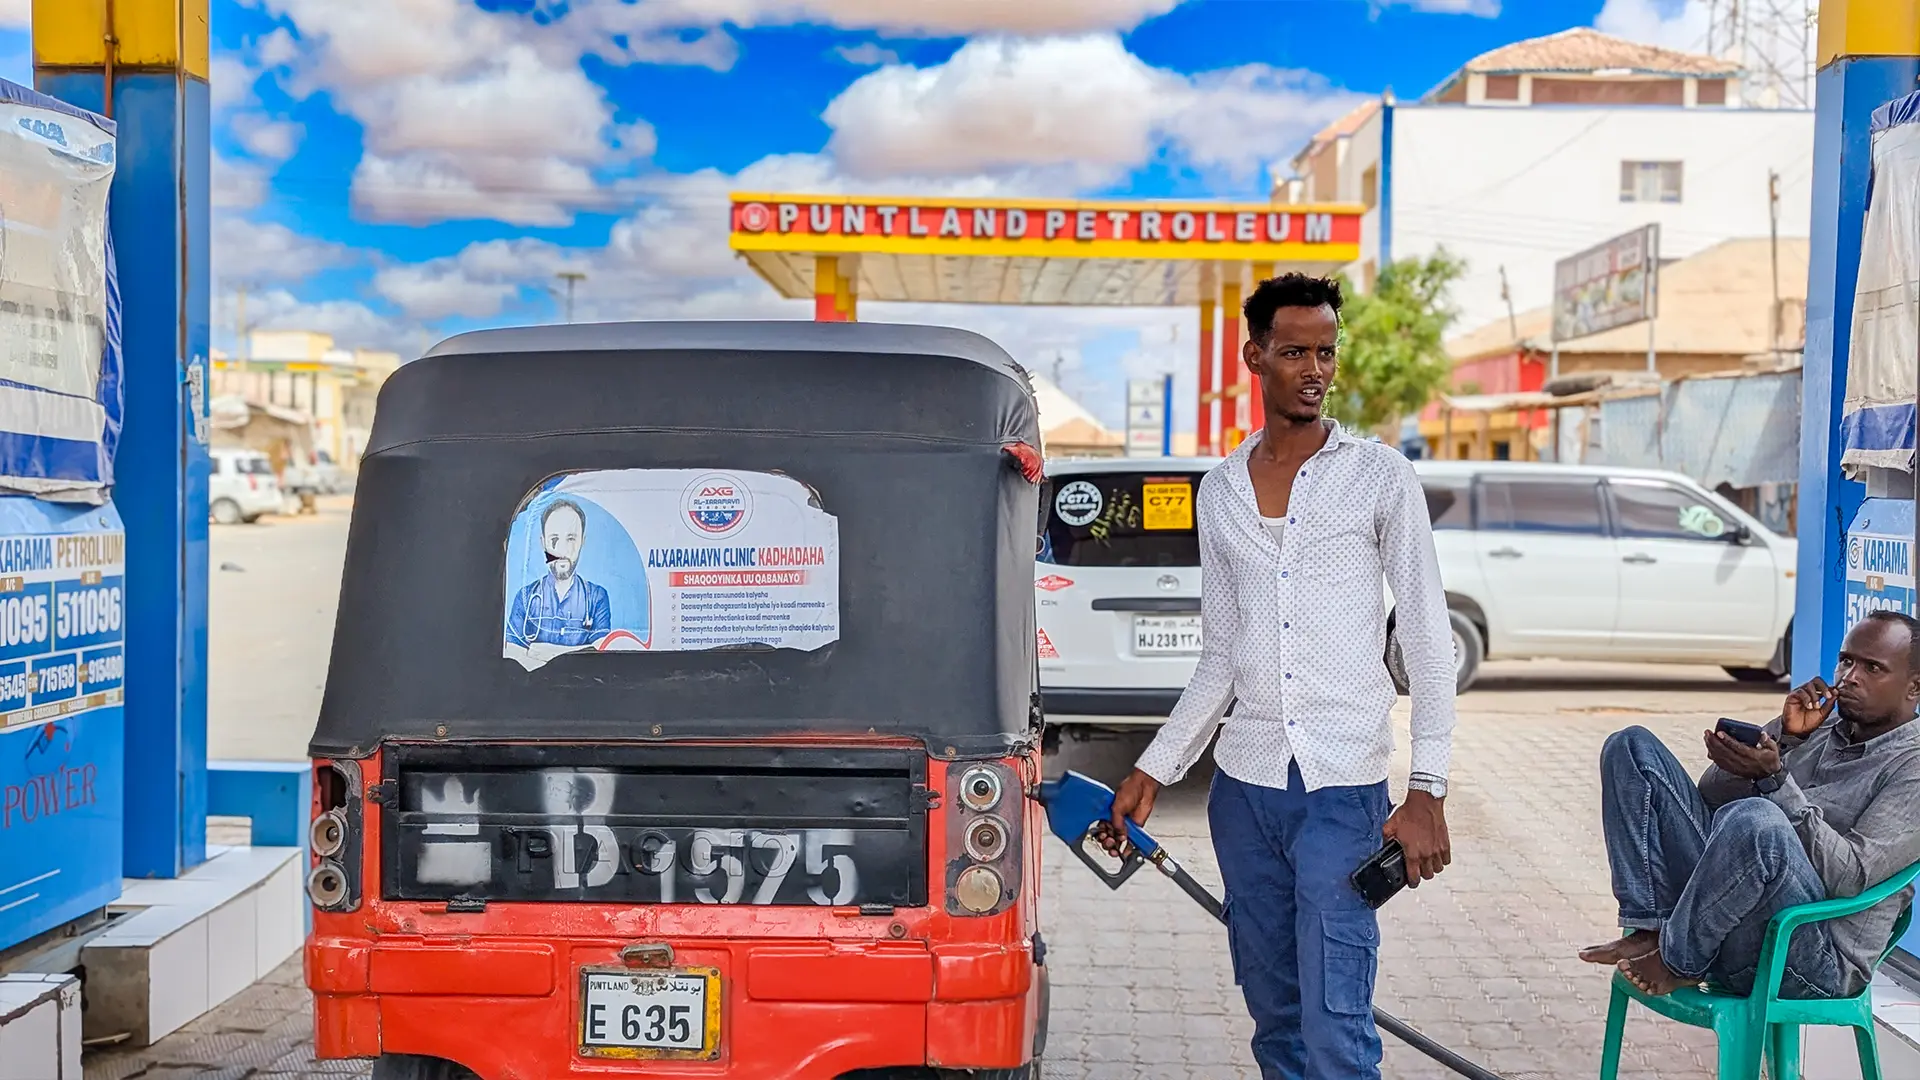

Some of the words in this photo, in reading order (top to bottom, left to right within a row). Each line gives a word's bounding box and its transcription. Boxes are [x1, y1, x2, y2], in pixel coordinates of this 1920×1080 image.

[778, 202, 1028, 238] PUNTLAND
[1044, 209, 1333, 243] PETROLEUM
[699, 487, 733, 496] AXG
[1066, 493, 1090, 503] C77
[1149, 496, 1185, 506] C77
[57, 535, 123, 568] PETROLIUM
[648, 547, 721, 568] ALXARAMAYN
[723, 547, 756, 567] CLINIC
[758, 546, 825, 566] KADHADAHA
[1862, 538, 1908, 576] KARAMA
[683, 574, 742, 585] SHAQOOYINKA
[743, 574, 755, 583] UU
[755, 573, 800, 584] QABANAYO
[57, 587, 121, 640] 511096
[1138, 633, 1154, 647] HJ
[1157, 633, 1178, 648] 238
[39, 663, 75, 694] 715158
[3, 762, 97, 830] POWER
[590, 981, 629, 991] PUNTLAND
[589, 1004, 606, 1039] E
[621, 1004, 691, 1043] 635
